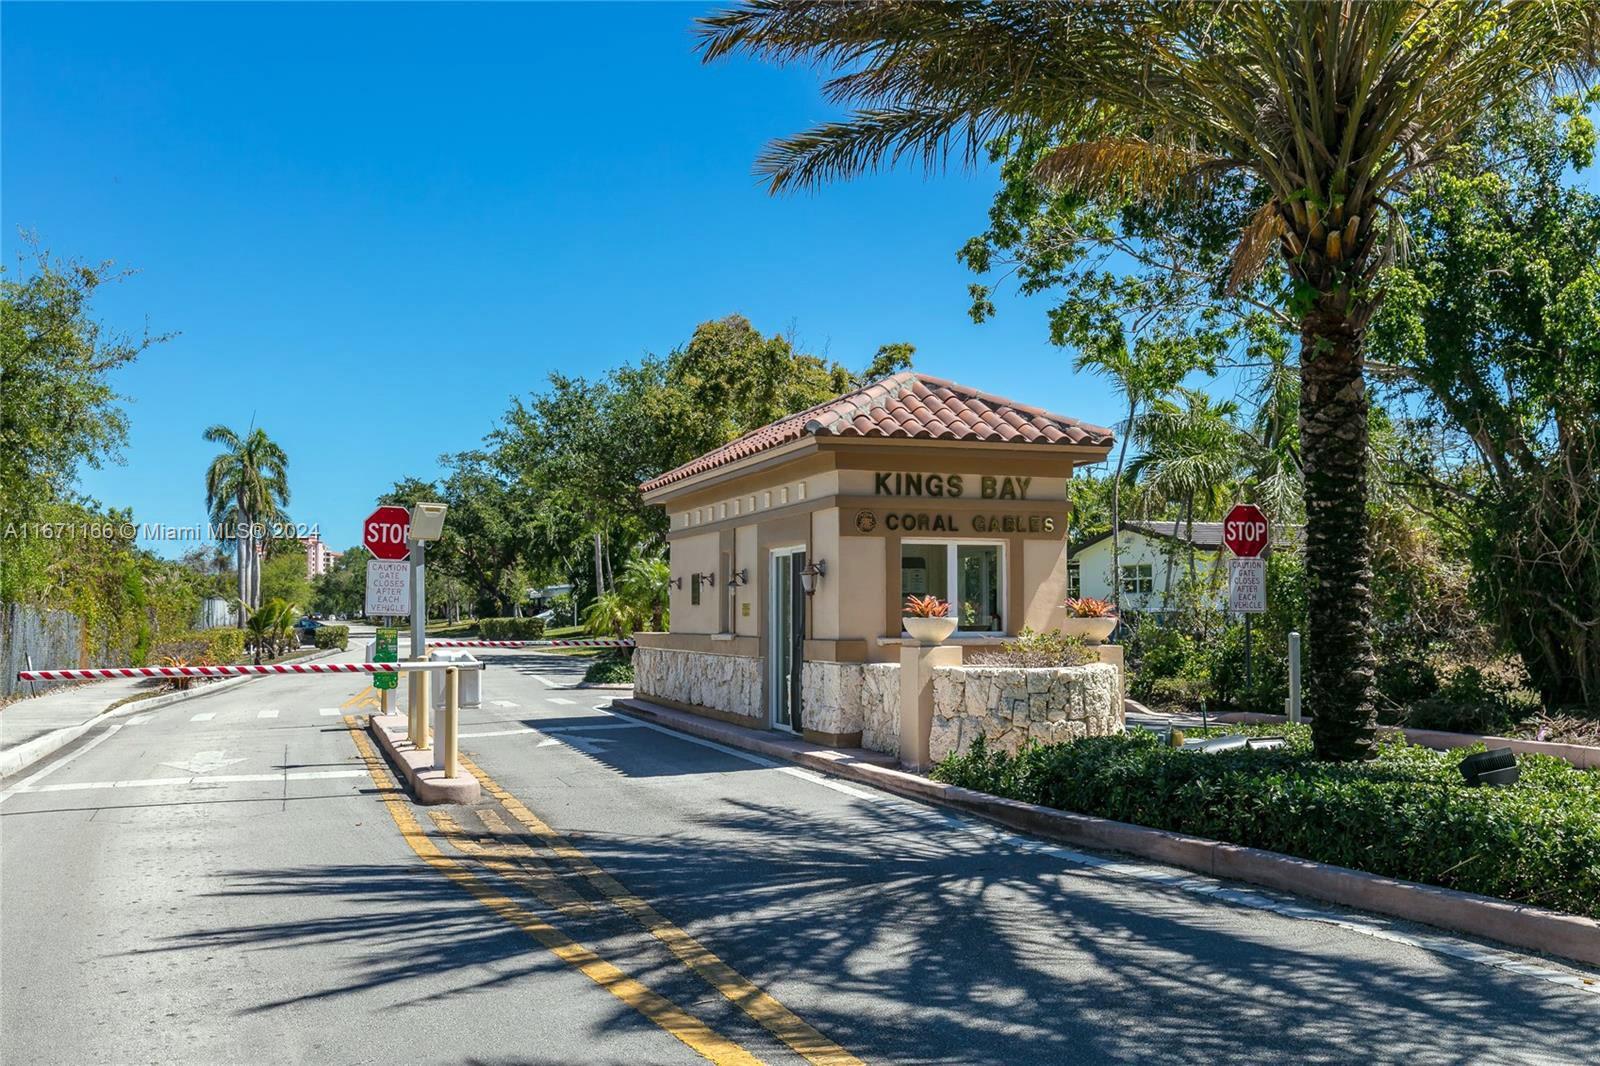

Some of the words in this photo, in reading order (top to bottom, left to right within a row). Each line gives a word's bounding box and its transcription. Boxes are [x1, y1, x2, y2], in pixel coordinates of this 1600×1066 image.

[875, 472, 964, 497] KINGS
[981, 475, 1032, 500] BAY
[885, 513, 959, 532] CORAL
[972, 515, 1055, 533] GABLES
[1226, 521, 1266, 541] STOP
[372, 564, 408, 572] CAUTION
[1232, 561, 1262, 569] CAUTION
[378, 572, 400, 580] GATE
[1234, 577, 1260, 585] CLOSES
[1238, 593, 1257, 601] EACH
[370, 604, 407, 612] VEHICLE
[1234, 601, 1262, 609] VEHICLE
